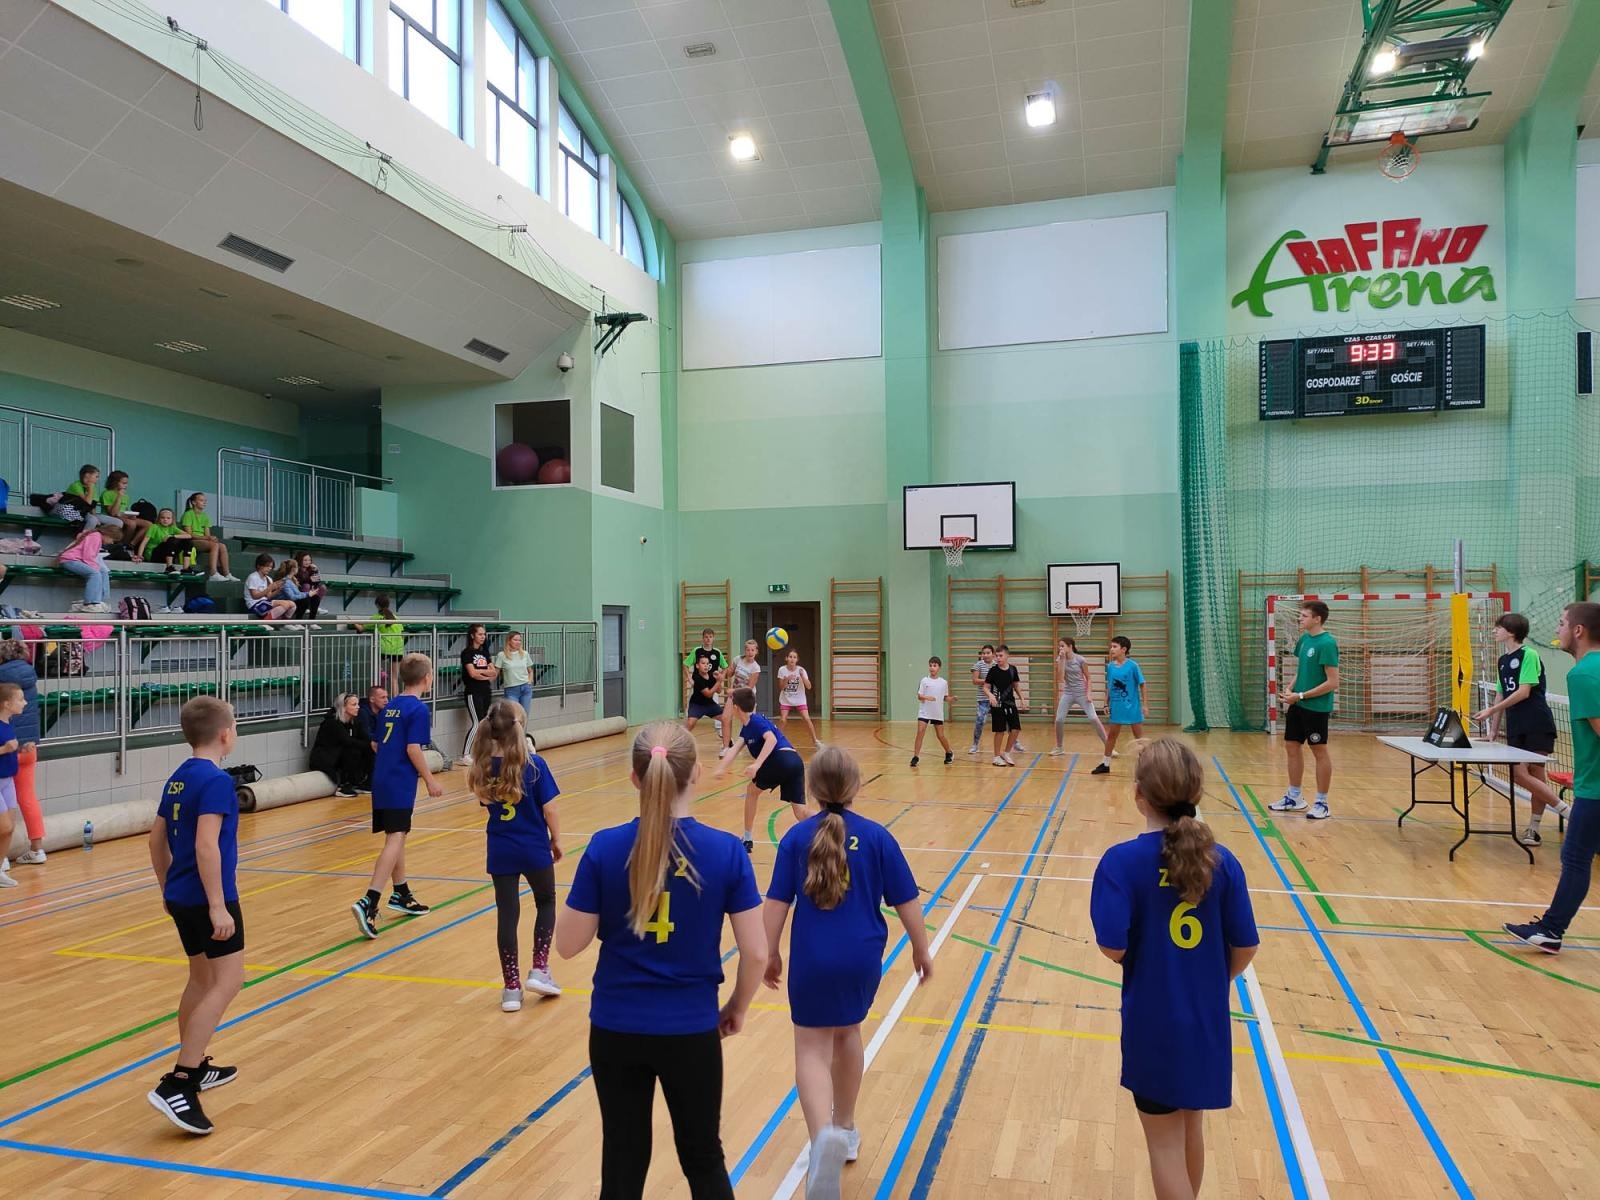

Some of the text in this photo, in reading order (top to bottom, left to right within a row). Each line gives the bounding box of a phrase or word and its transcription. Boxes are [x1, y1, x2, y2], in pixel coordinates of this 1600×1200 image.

[1286, 218, 1488, 276] RAFAKO
[1232, 230, 1497, 317] Arena
[1351, 342, 1394, 362] 9:33
[1306, 376, 1360, 388] GOSPODARZE
[1391, 370, 1422, 383] GOŚCIE
[383, 722, 393, 744] 7
[168, 782, 184, 794] ZSP
[849, 836, 858, 850] 2
[674, 857, 688, 876] 2
[642, 892, 674, 944] 4
[1170, 901, 1203, 949] 6
